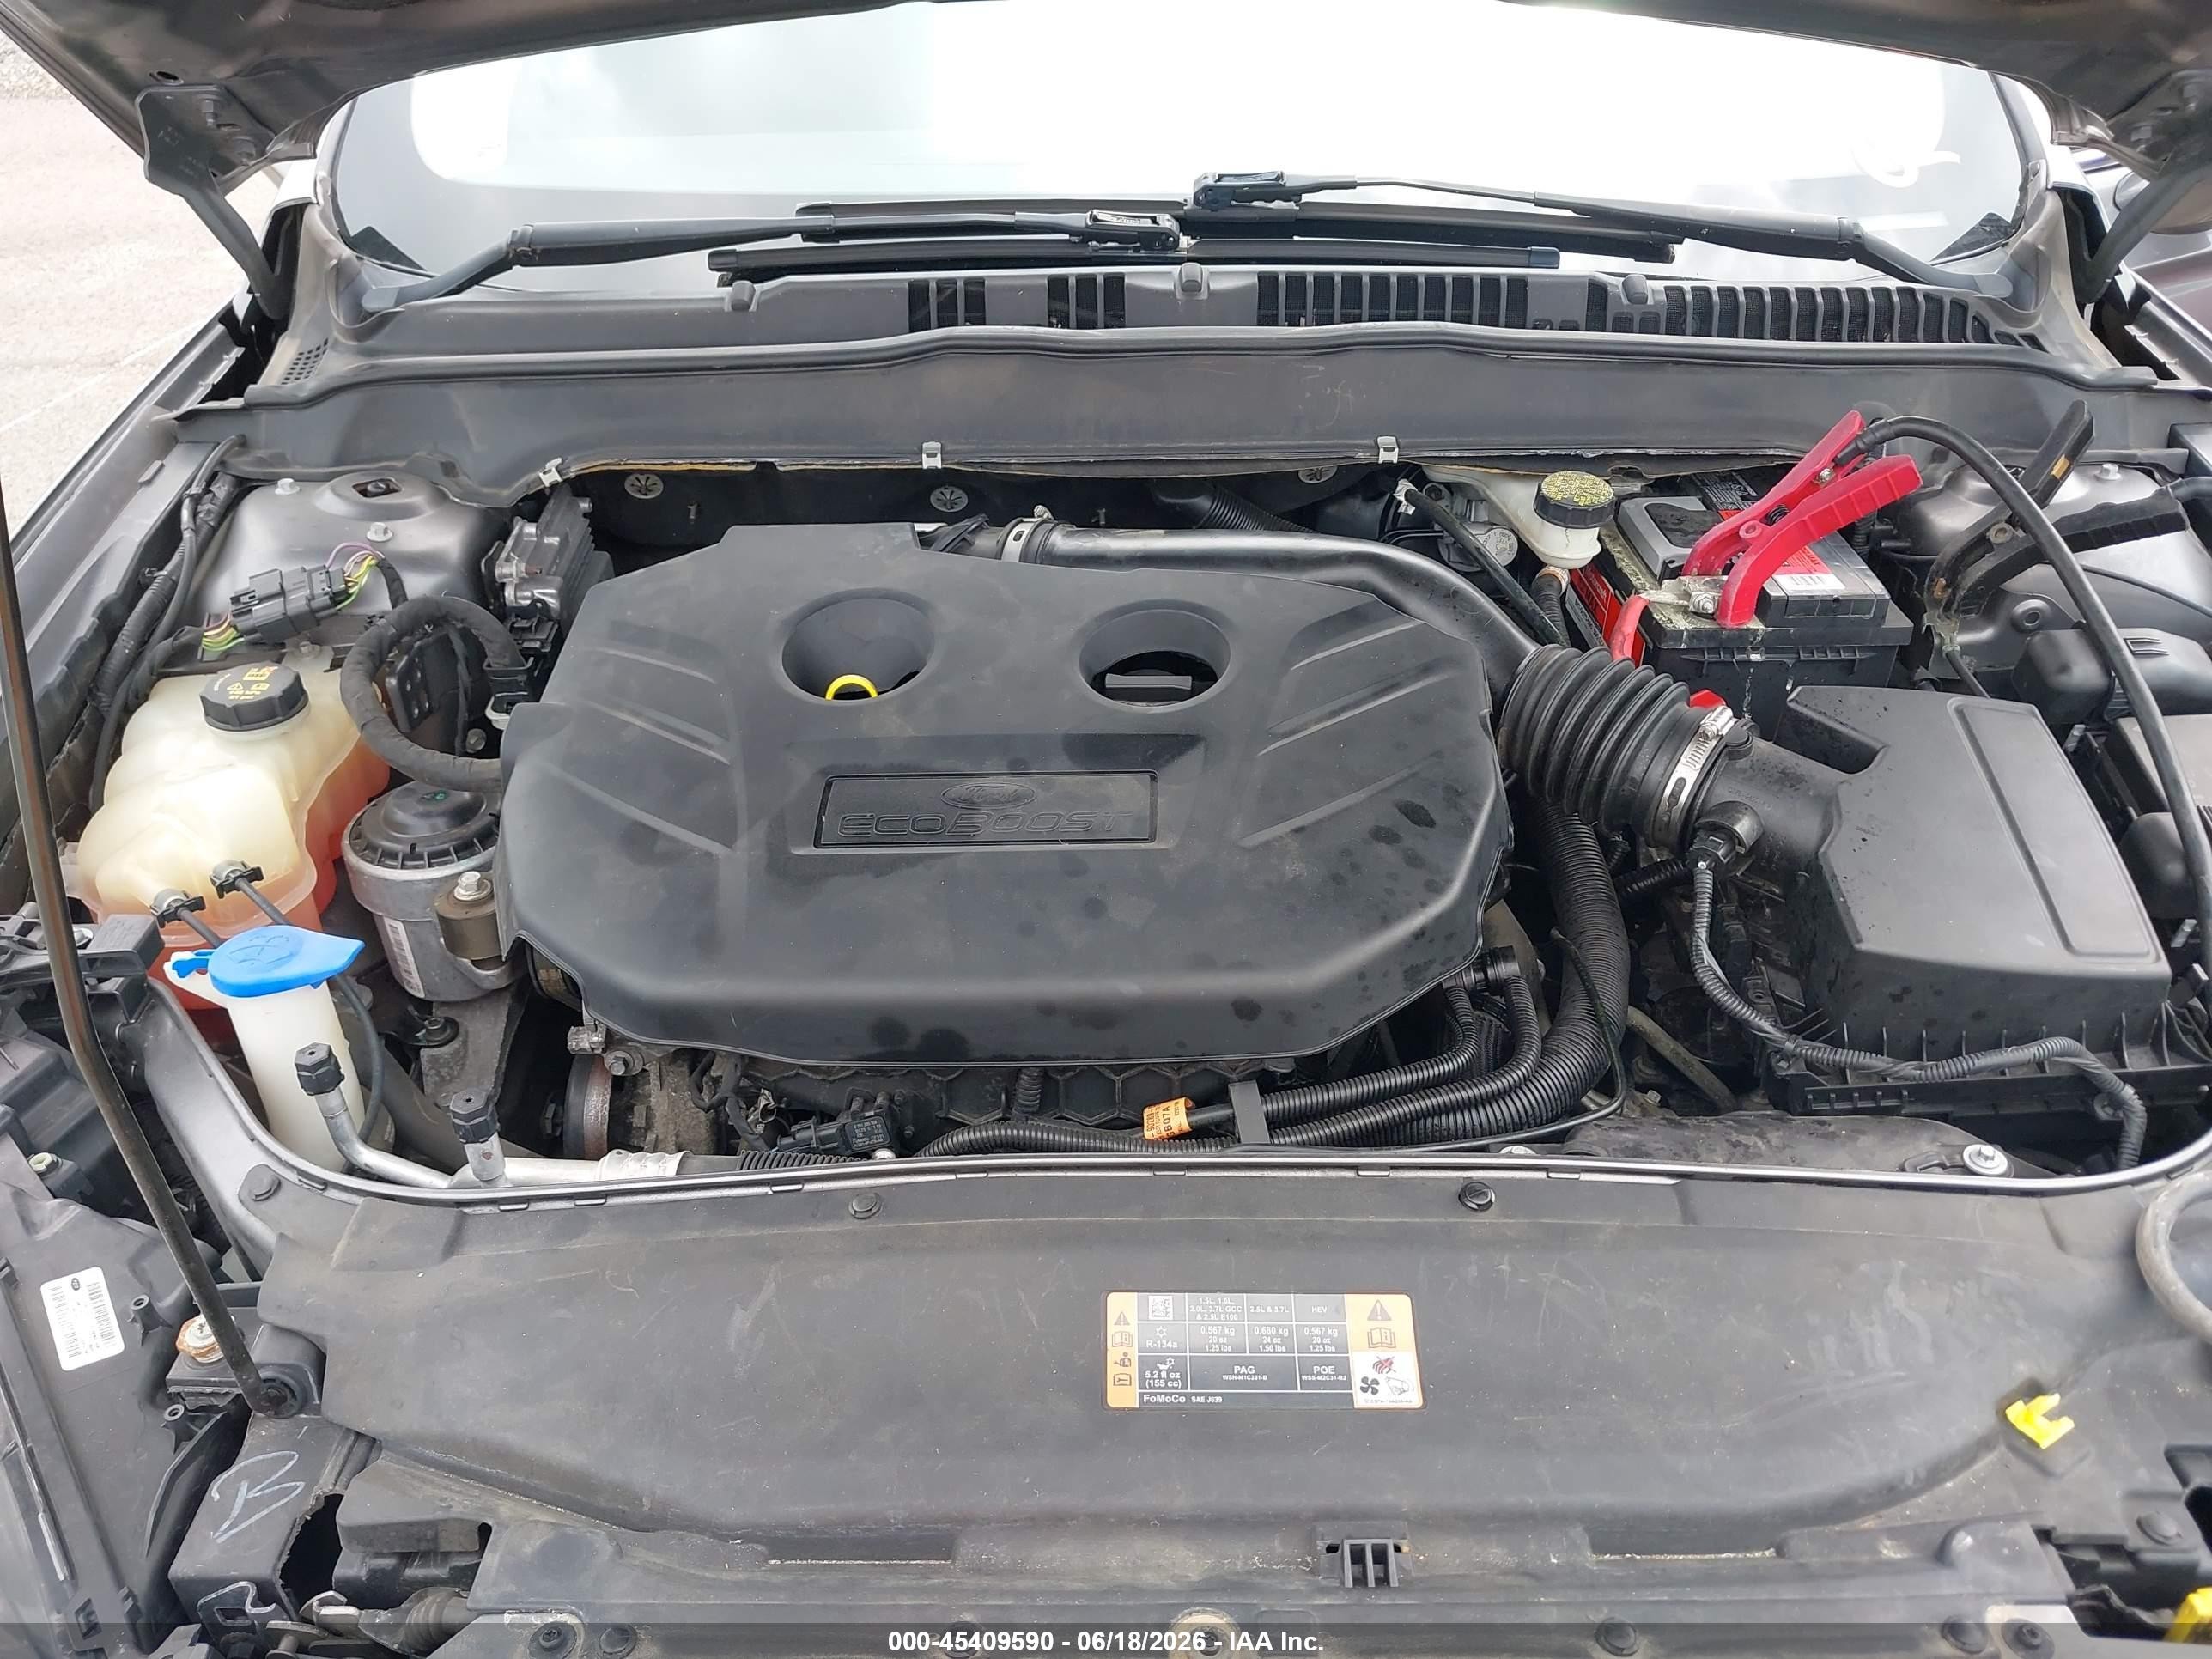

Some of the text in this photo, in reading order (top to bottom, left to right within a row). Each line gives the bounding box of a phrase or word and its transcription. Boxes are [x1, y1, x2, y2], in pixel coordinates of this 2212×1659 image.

[1201, 1326, 1235, 1336] 0.567 kg
[1278, 1326, 1289, 1337] kg
[1304, 1327, 1338, 1337] 0.567 kg
[1146, 1340, 1178, 1348] R-134a
[1234, 1366, 1255, 1374] PAG
[1313, 1366, 1335, 1374] POE
[1145, 1371, 1159, 1379] 5.2
[1146, 1379, 1182, 1389] (155 cc)
[1143, 1394, 1186, 1403] FoMoCo
